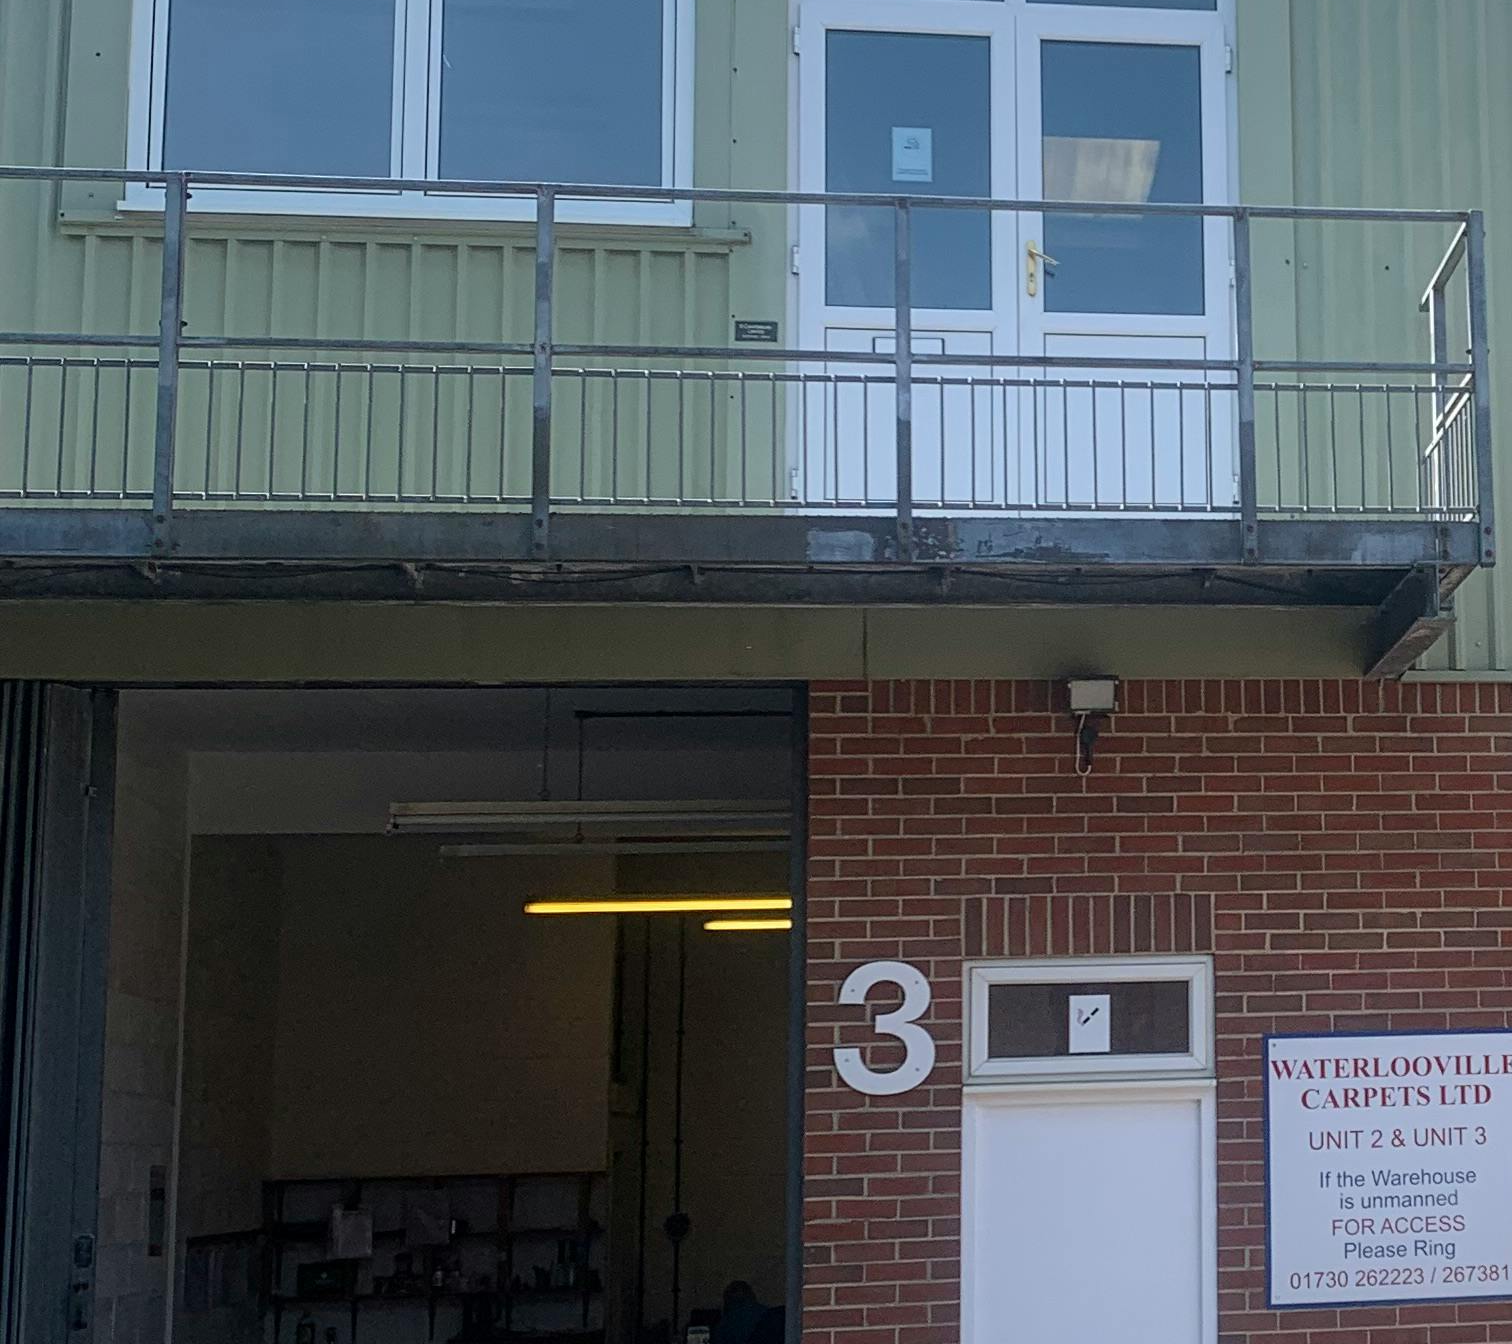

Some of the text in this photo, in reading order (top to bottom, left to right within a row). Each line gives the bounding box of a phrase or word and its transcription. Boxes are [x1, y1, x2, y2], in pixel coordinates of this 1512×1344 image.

[833, 960, 936, 1096] 3
[1301, 1084, 1492, 1110] CARPETS LTD
[1309, 1126, 1487, 1150] UNIT 2 & UNIT 3
[1319, 1168, 1477, 1188] If the Warehouse
[1339, 1190, 1458, 1209] is unmanned
[1332, 1215, 1465, 1236] FOR ACCESS
[1344, 1240, 1456, 1260] Please Ring
[1290, 1264, 1509, 1289] 01730 262223 / 267381
